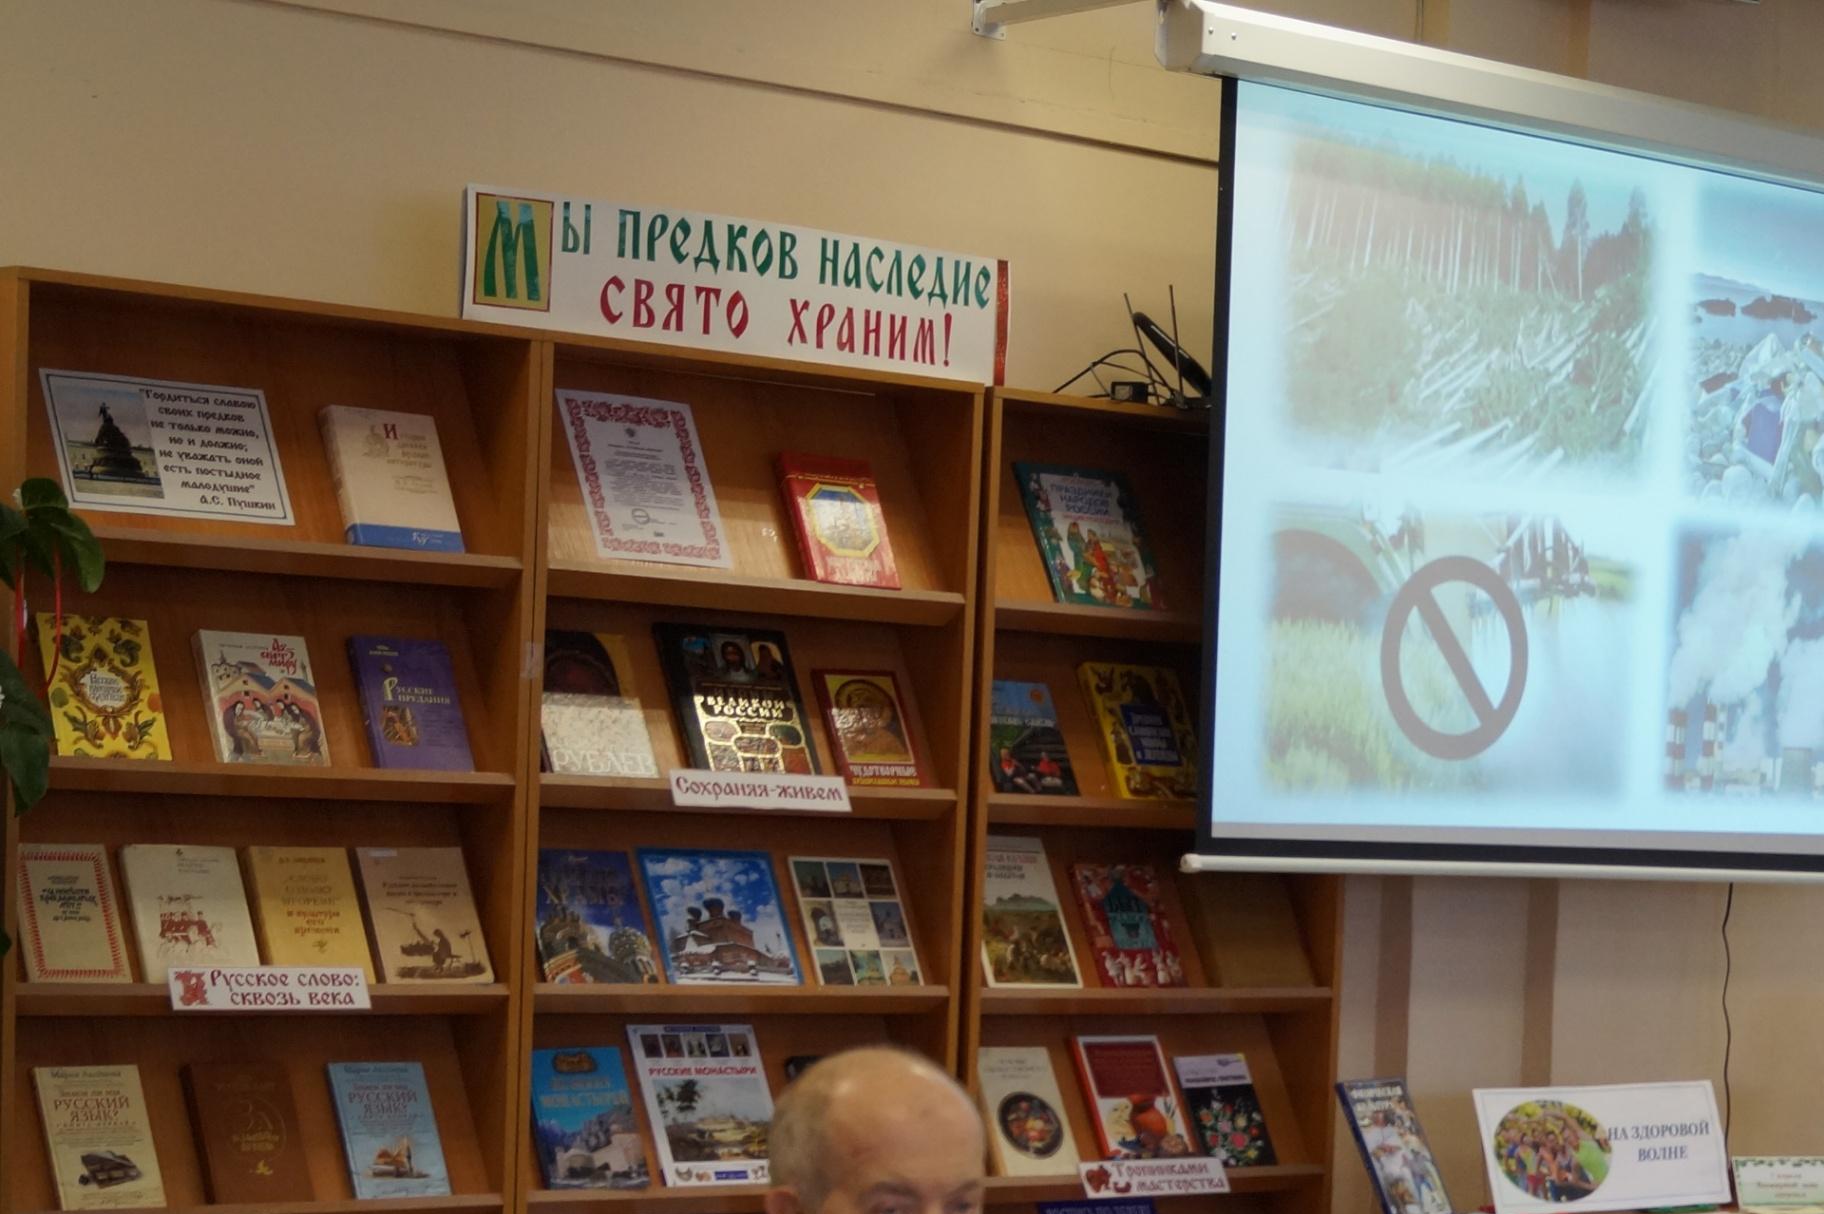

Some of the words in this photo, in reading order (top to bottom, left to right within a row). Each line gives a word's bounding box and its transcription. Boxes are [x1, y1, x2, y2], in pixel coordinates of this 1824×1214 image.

[600, 274, 749, 339] СВЯТО
[213, 397, 257, 409] славою
[158, 406, 193, 418] своих
[197, 410, 245, 423] предков
[150, 420, 164, 429] не
[168, 421, 211, 433] только
[168, 436, 183, 445] но
[187, 438, 196, 446] и
[159, 450, 173, 458] не
[177, 451, 231, 464] уважать
[235, 456, 264, 466] оной
[163, 465, 191, 475] есть
[195, 467, 261, 481] постыдное
[227, 497, 276, 511] Пушкин
[211, 970, 289, 991] Русское
[54, 1096, 129, 1111] РУССКИЙ
[348, 1089, 418, 1104] РУССКИЙ
[1608, 1126, 1629, 1141] НА
[1632, 1121, 1711, 1139] ЗДОРОВОЙ
[1637, 1145, 1689, 1163] ВОЛНЕ
